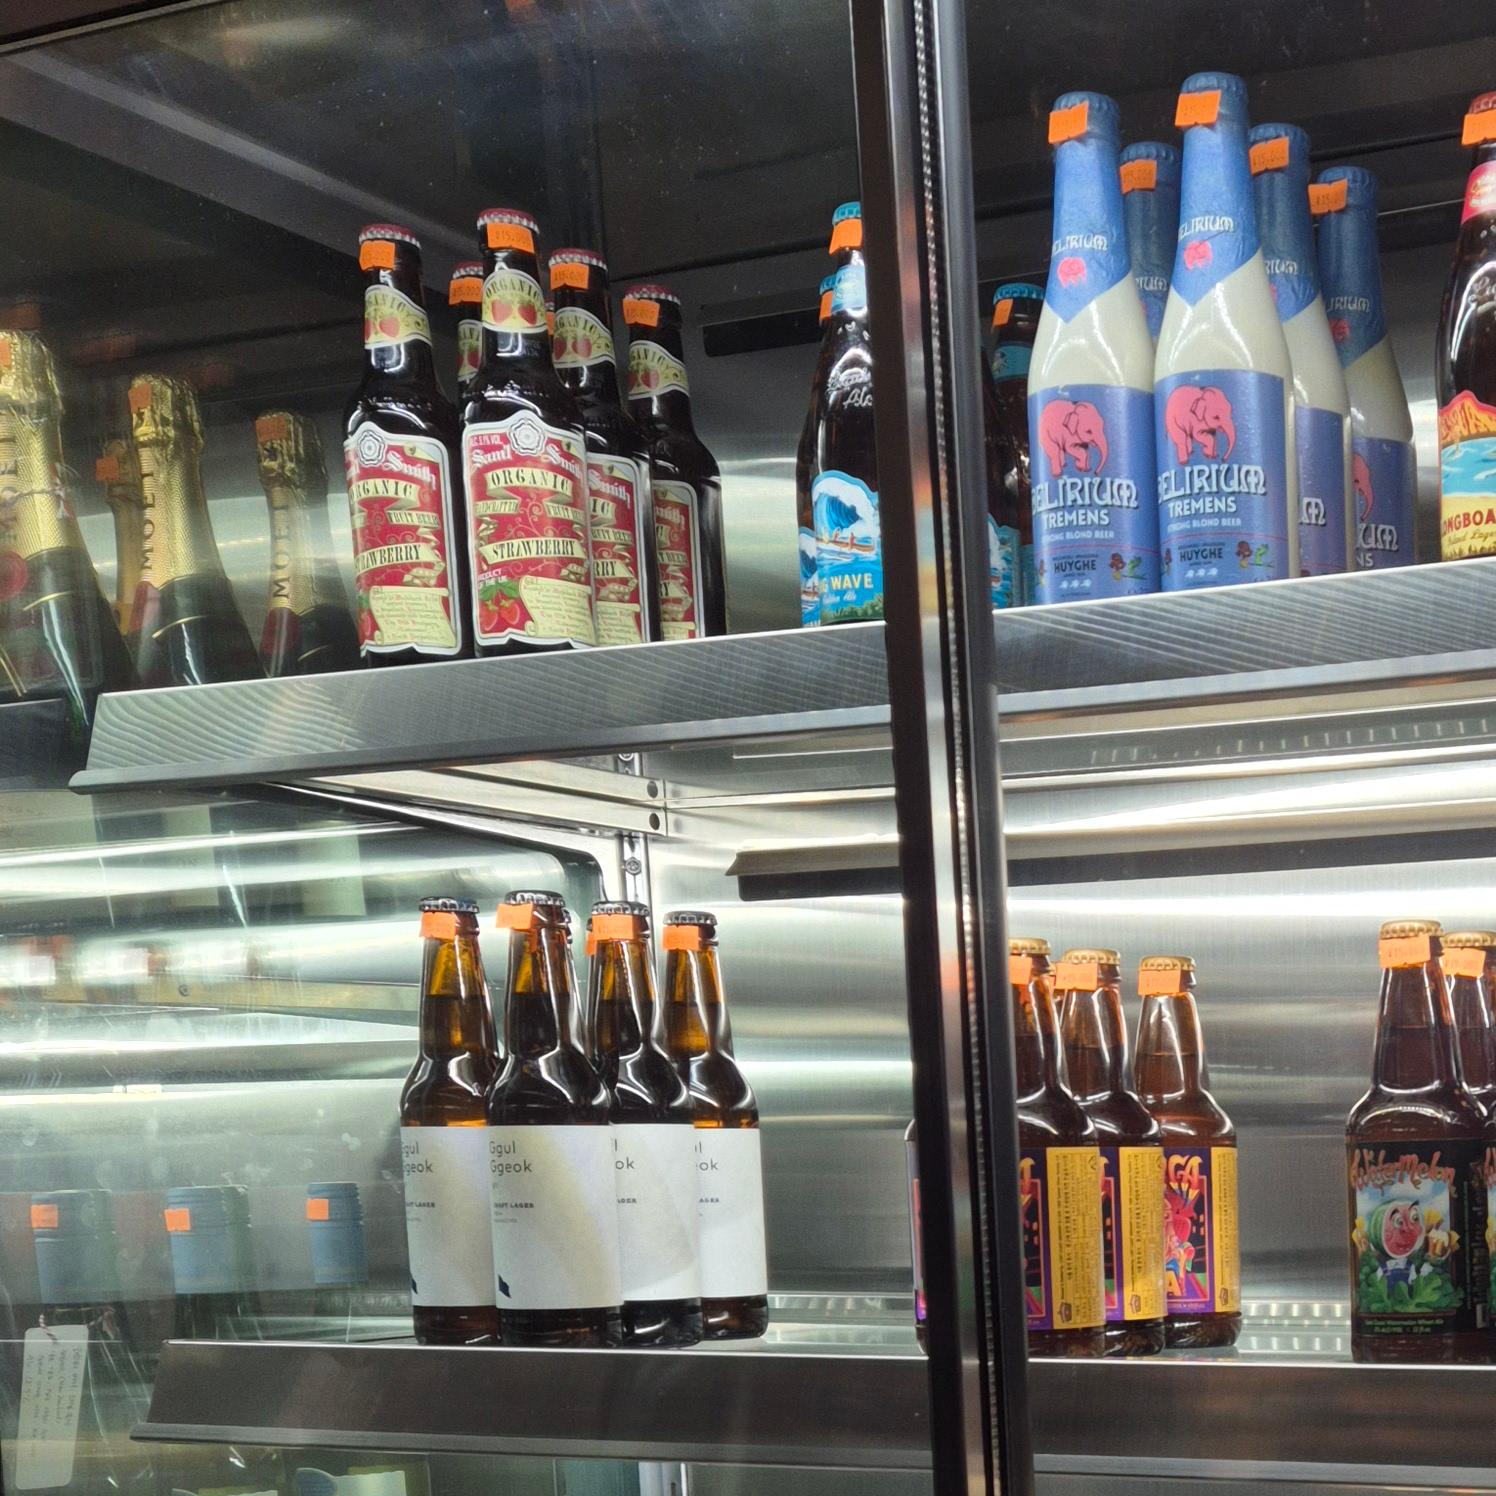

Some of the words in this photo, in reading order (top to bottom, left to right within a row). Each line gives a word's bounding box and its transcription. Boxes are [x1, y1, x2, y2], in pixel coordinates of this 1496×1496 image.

[491, 469, 570, 490] ORGANIC
[1168, 496, 1237, 518] TREMENS
[1044, 510, 1110, 529] TREMENS
[492, 539, 576, 559] STRAWBERRY
[1179, 548, 1224, 563] HUYGHE
[1053, 559, 1097, 573] HUYGHE
[830, 573, 874, 591] WAVE
[489, 1141, 516, 1156] Ggul
[490, 1160, 533, 1176] Ggeok
